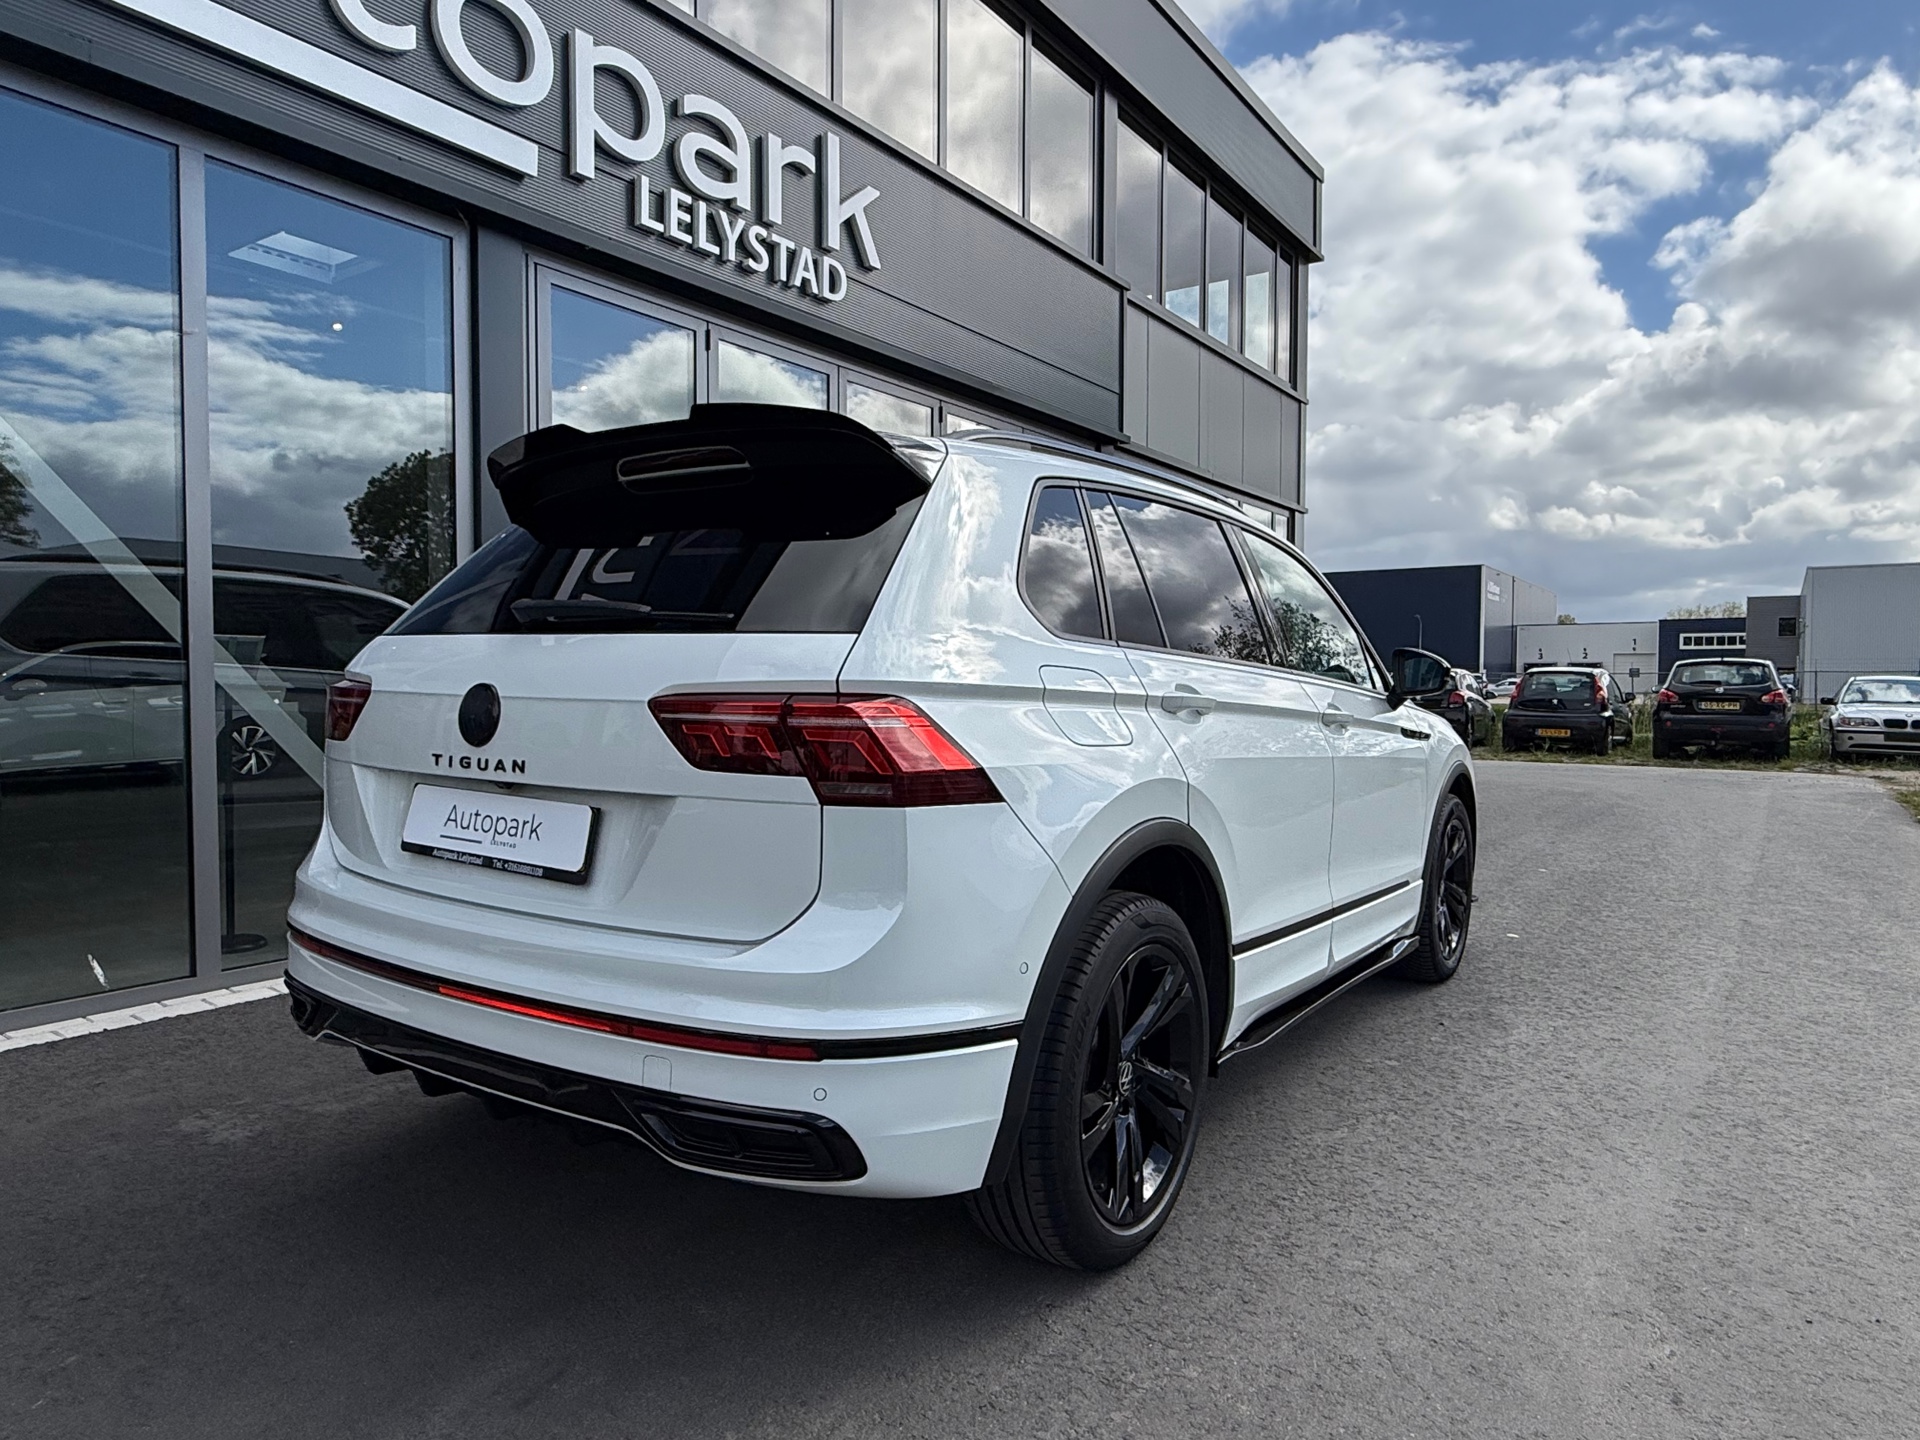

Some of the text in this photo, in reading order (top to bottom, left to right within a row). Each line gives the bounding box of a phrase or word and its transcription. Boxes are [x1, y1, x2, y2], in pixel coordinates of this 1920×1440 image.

[330, 0, 881, 270] opark
[633, 174, 848, 302] LELYSTAD
[1582, 652, 1588, 660] 2
[431, 753, 526, 774] TIGUAN
[444, 804, 543, 841] Autopark
